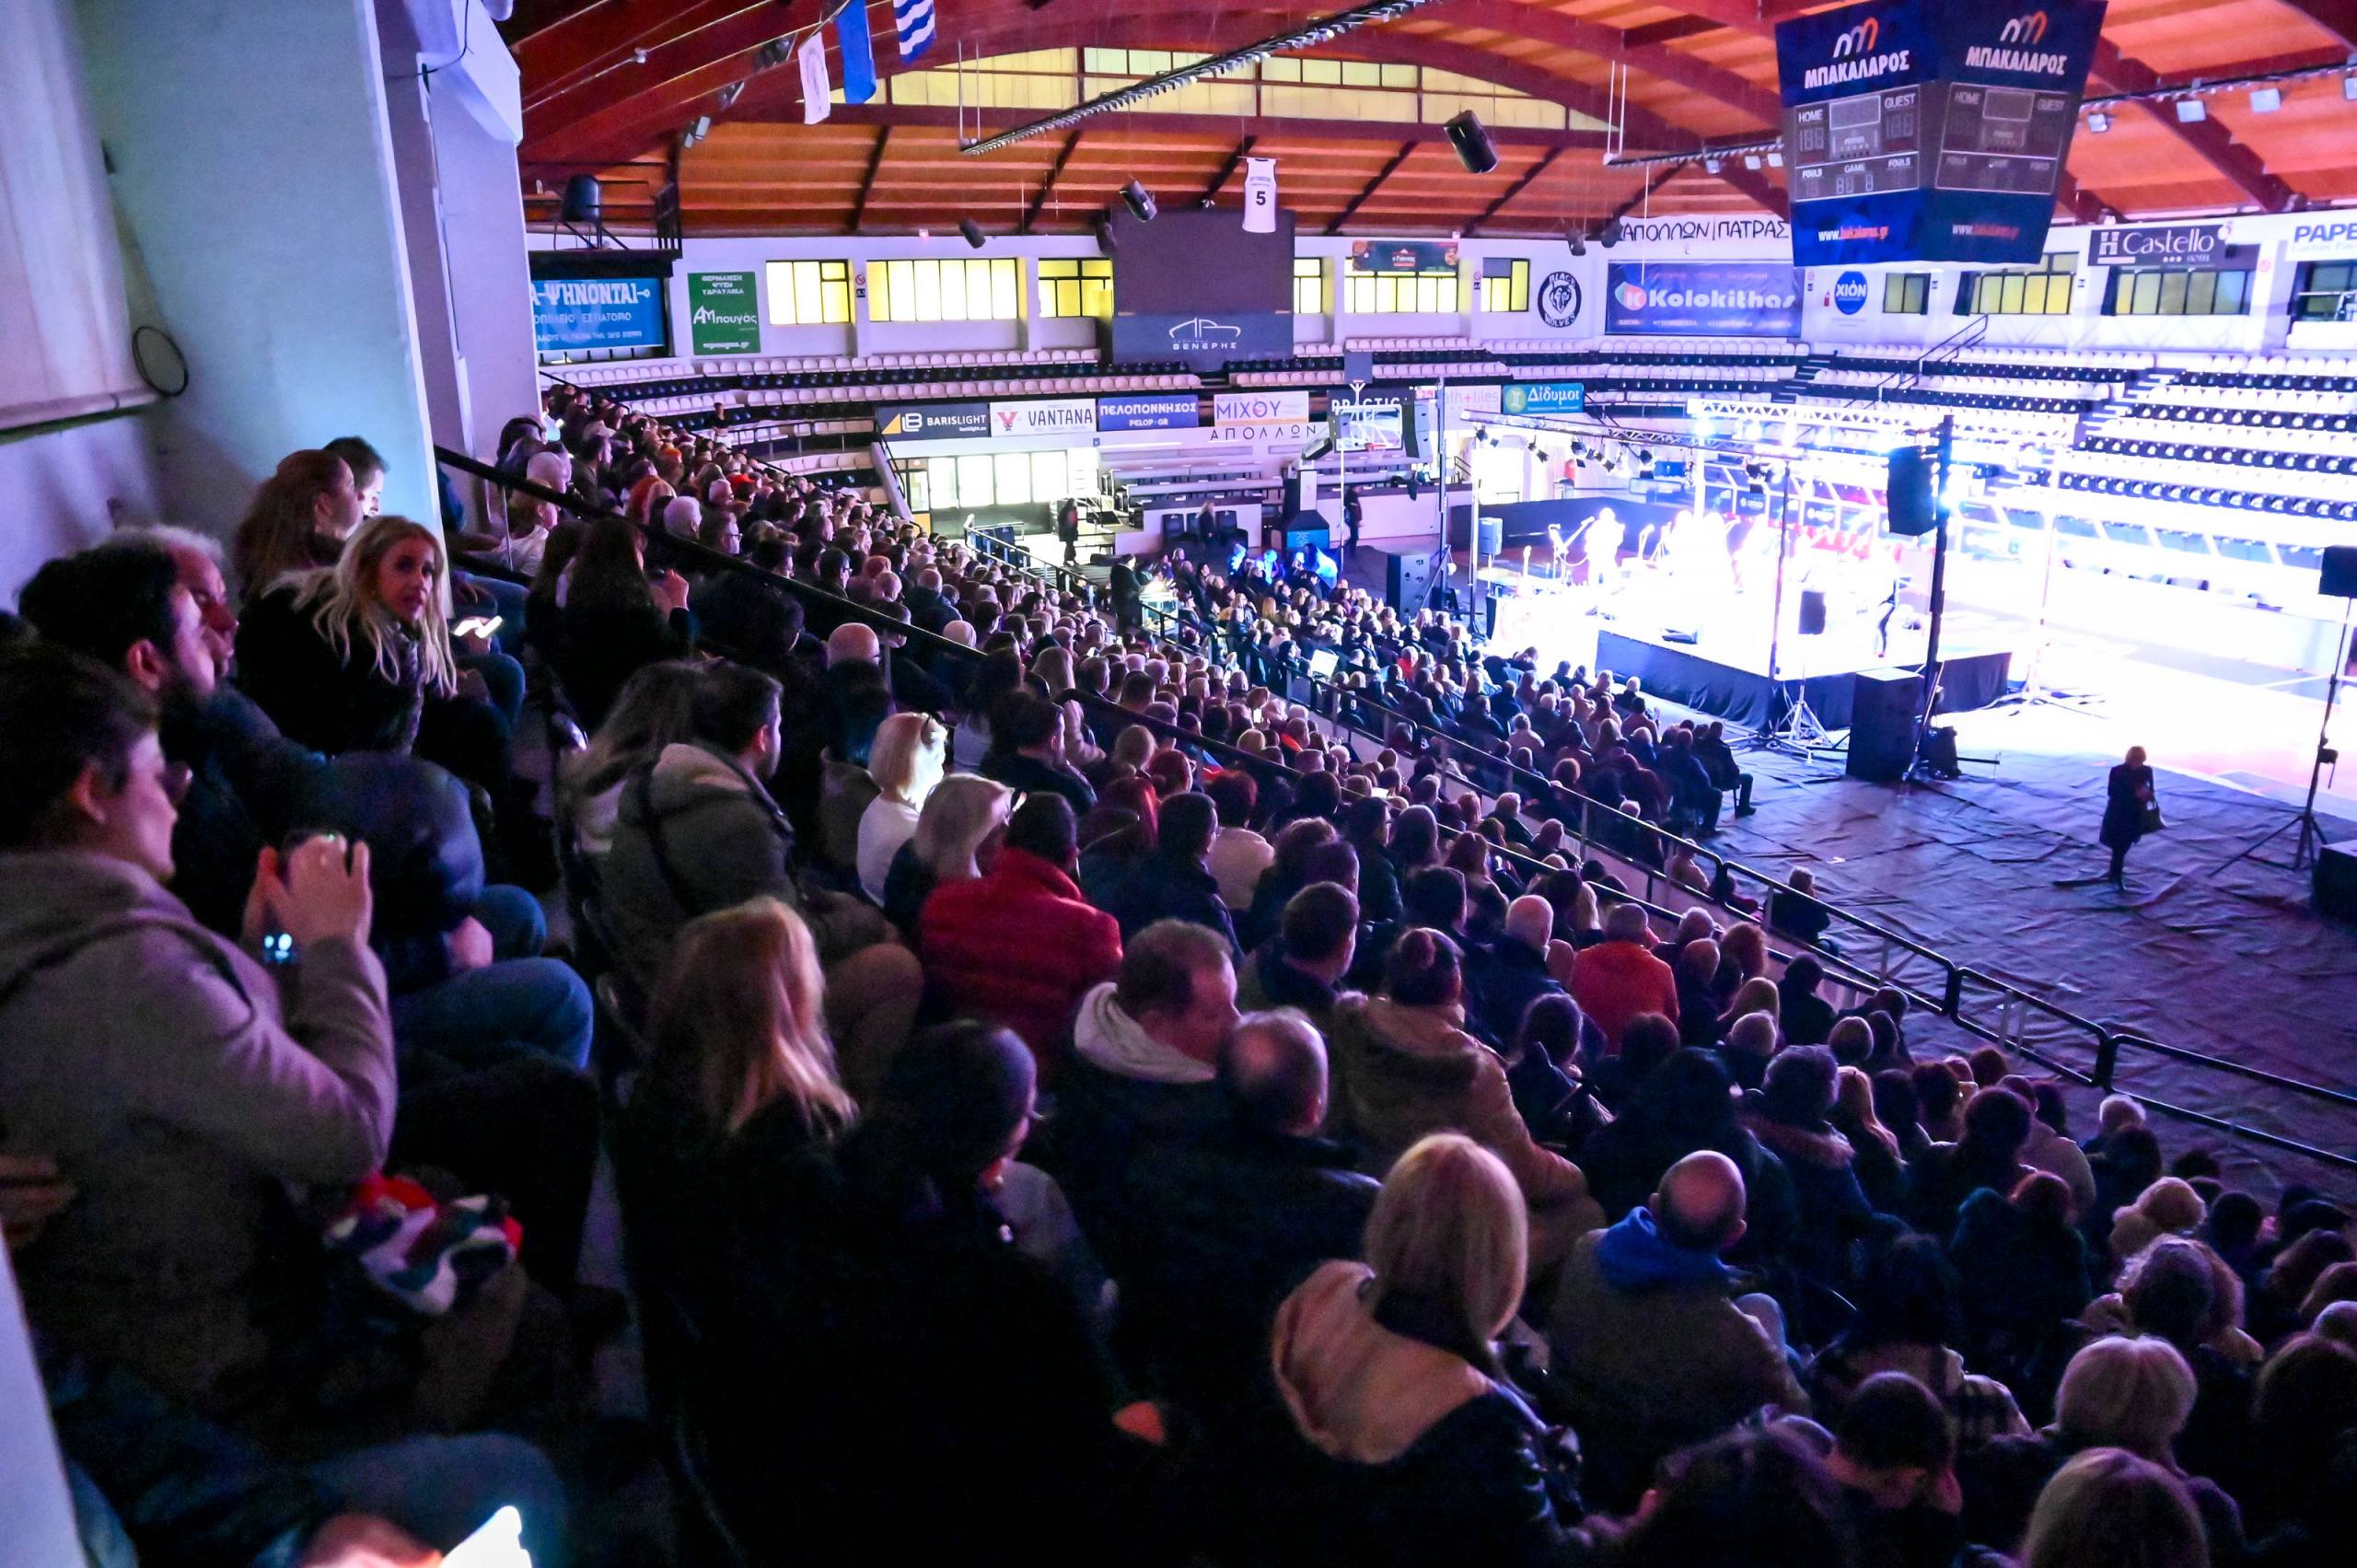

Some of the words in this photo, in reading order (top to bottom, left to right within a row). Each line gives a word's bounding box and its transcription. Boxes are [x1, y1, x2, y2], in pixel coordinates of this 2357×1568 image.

[1805, 50, 1910, 88] ΜΠΑΚΑΛΑΡΟΣ
[1966, 46, 2068, 75] ΜΠΑΚΑΛΑΡΟΣ
[1884, 93, 1916, 110] GUEST
[1798, 110, 1823, 122] HOME
[1888, 157, 1911, 168] FOULS
[1802, 168, 1823, 179] FOULS
[1256, 191, 1266, 205] 5
[1622, 221, 1711, 242] ΑΠΟΛΛΩΝ
[1718, 220, 1789, 239] ΠΑΤΡΑΣ
[2122, 228, 2214, 255] Castello
[1549, 273, 1575, 286] BLACK
[1649, 289, 1795, 309] Kolokithas
[1527, 386, 1580, 406] Δίδυμοι
[1028, 408, 1093, 426] VANTANA
[1216, 401, 1281, 420] ΜΙΧΟΥ
[926, 414, 987, 426] BARISLIGHT
